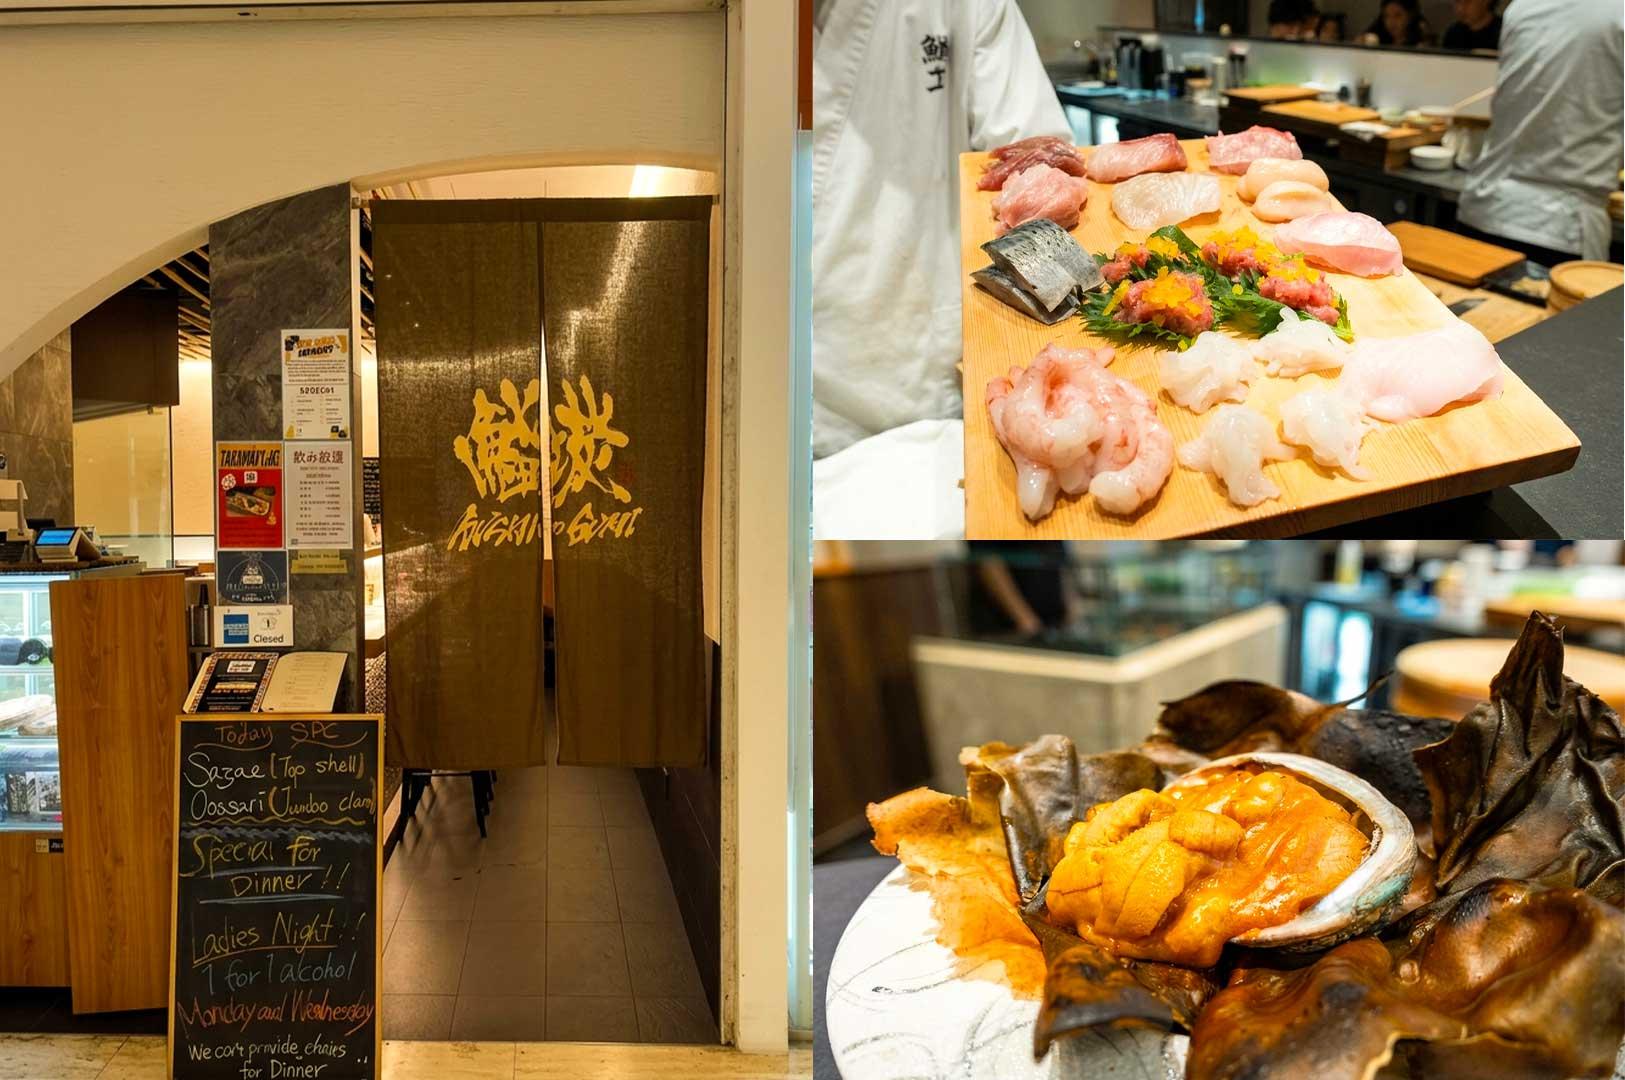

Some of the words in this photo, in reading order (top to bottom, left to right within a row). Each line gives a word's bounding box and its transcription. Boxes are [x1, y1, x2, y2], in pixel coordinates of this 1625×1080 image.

[254, 634, 285, 644] Closed
[215, 722, 273, 747] Today
[290, 720, 340, 743] SPC
[184, 752, 265, 790] Sazae
[179, 834, 274, 879] Special
[231, 872, 313, 896] Dinner
[192, 914, 260, 964] Ladies
[272, 908, 334, 954] Night
[201, 963, 215, 995] 1
[177, 997, 256, 1038] Monday
[257, 992, 285, 1022] and
[188, 1043, 212, 1061] We
[248, 1034, 299, 1063] provide
[304, 1033, 346, 1058] chairs
[240, 1059, 263, 1079] for
[270, 1059, 328, 1079] Dinner
